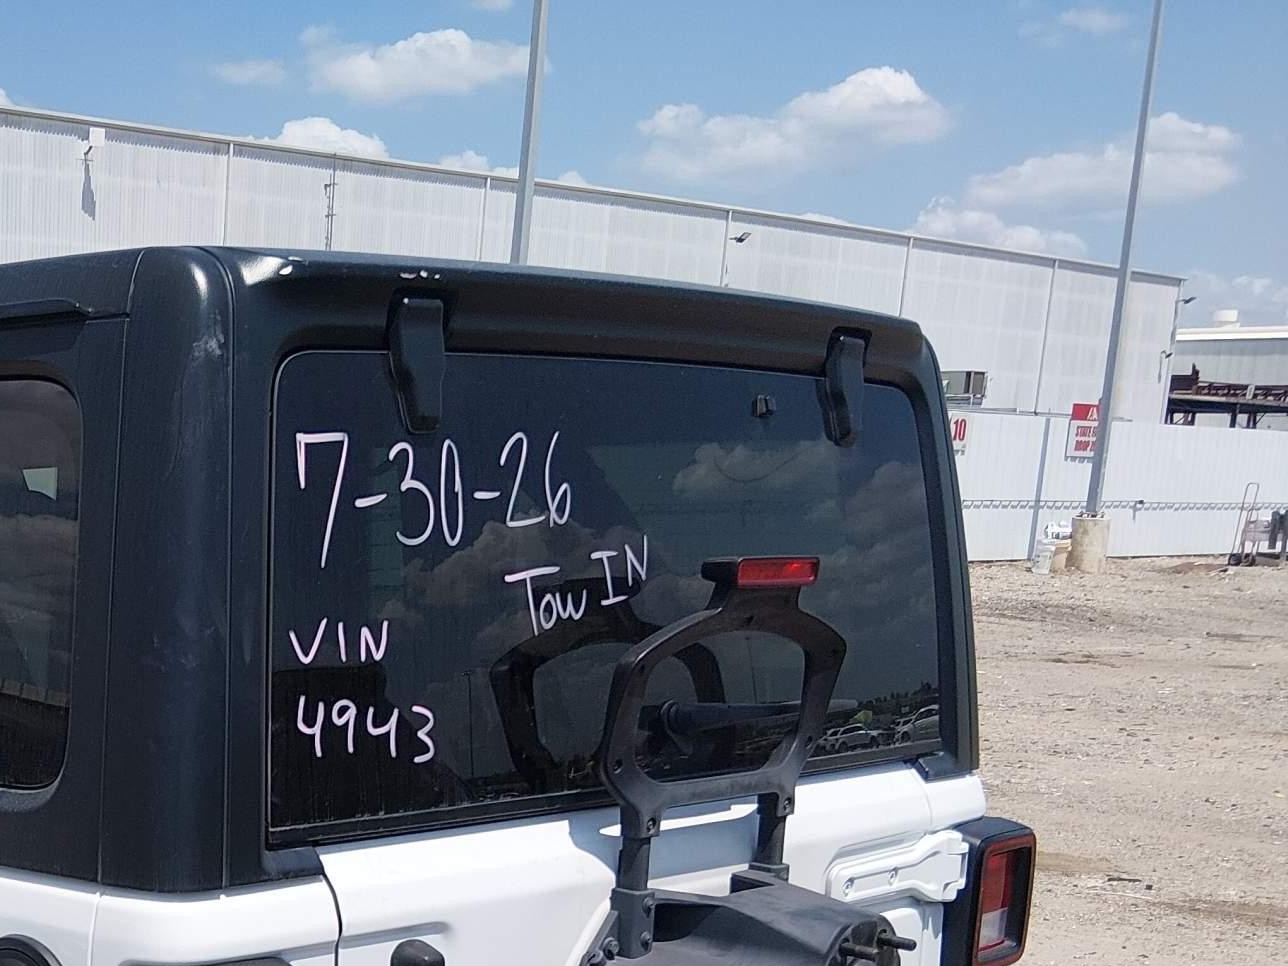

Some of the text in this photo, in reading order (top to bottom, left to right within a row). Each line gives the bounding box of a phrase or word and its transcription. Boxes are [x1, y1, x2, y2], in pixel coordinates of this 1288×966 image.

[952, 418, 967, 441] 10
[295, 431, 571, 568] 7-30-26
[590, 534, 648, 606] IN
[288, 617, 389, 664] VIN
[296, 695, 436, 764] 4943
